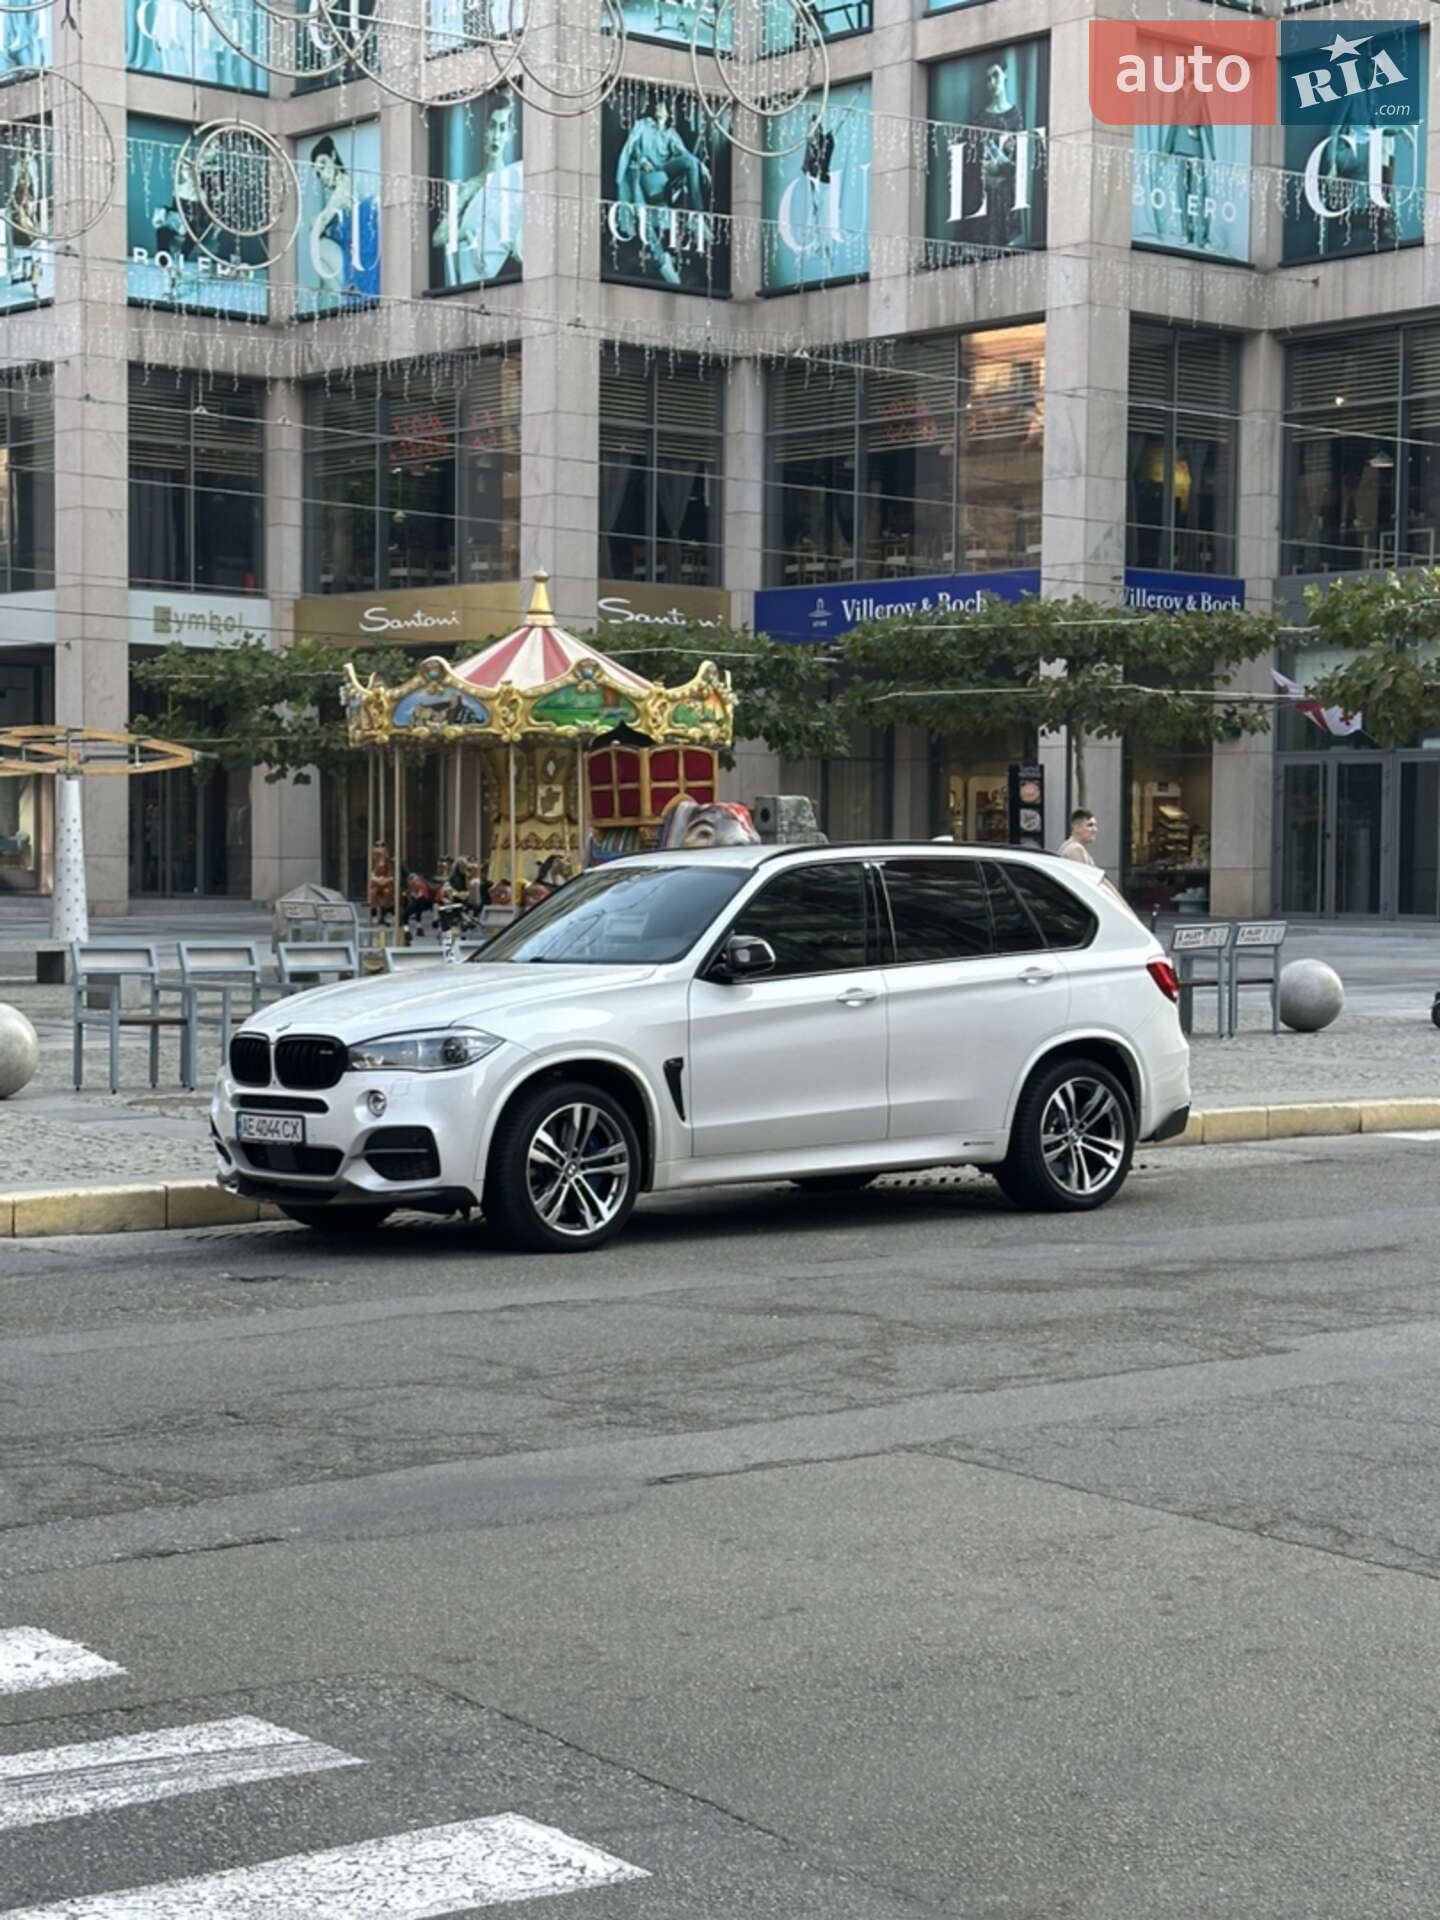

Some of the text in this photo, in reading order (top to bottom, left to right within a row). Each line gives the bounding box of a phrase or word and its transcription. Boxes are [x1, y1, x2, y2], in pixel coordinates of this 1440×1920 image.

[946, 126, 1047, 223] LT
[1131, 184, 1236, 223] BOLERO
[597, 597, 724, 629] Santni
[840, 597, 918, 623] Villeroy
[1185, 594, 1198, 612] &
[358, 607, 461, 632] Santoni
[282, 1120, 300, 1139] CX
